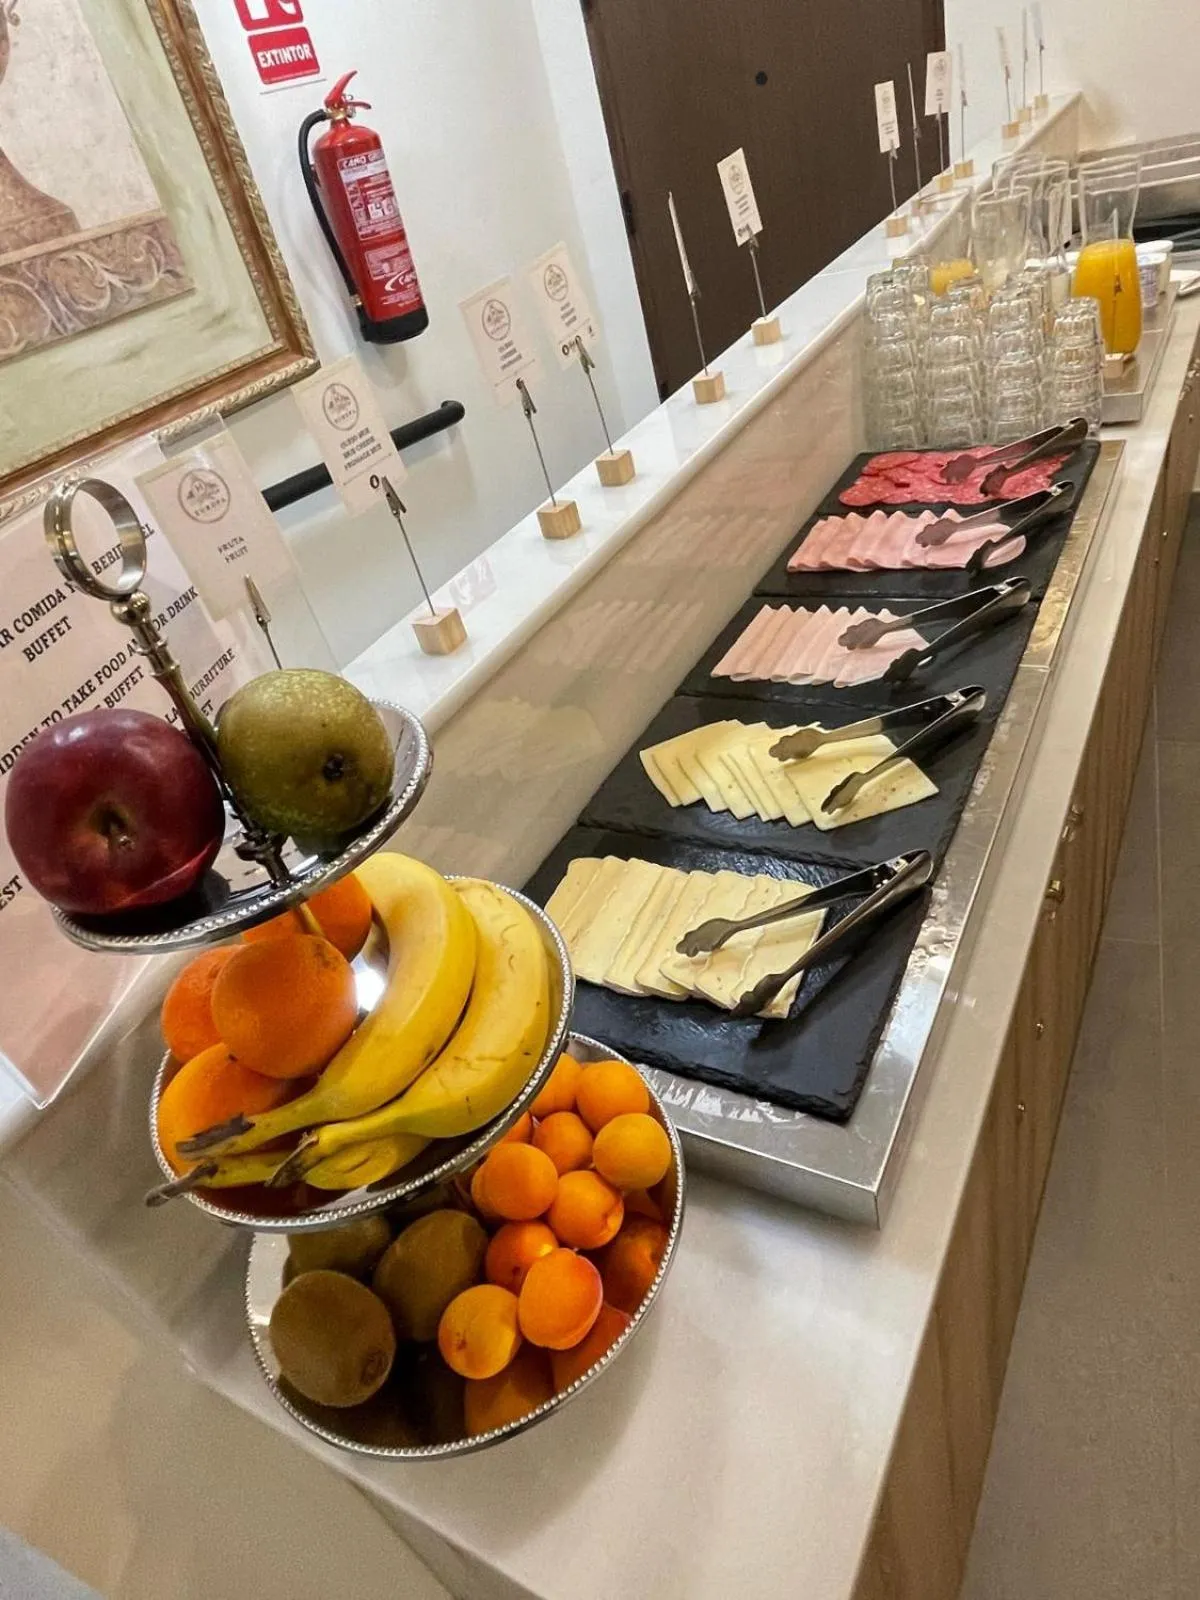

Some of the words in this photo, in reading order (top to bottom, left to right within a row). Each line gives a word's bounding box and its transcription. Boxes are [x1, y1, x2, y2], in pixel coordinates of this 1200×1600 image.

[257, 43, 312, 68] EXTINTOR
[217, 536, 245, 554] FRUTA
[224, 545, 249, 564] FRUIT
[13, 588, 67, 634] COMIDA
[166, 586, 199, 619] DRINK
[22, 615, 73, 663] BUFFET
[62, 679, 97, 714] TAKE
[94, 652, 127, 686] FOOD
[103, 665, 145, 710] BUFFET
[189, 647, 236, 701] URRITURE
